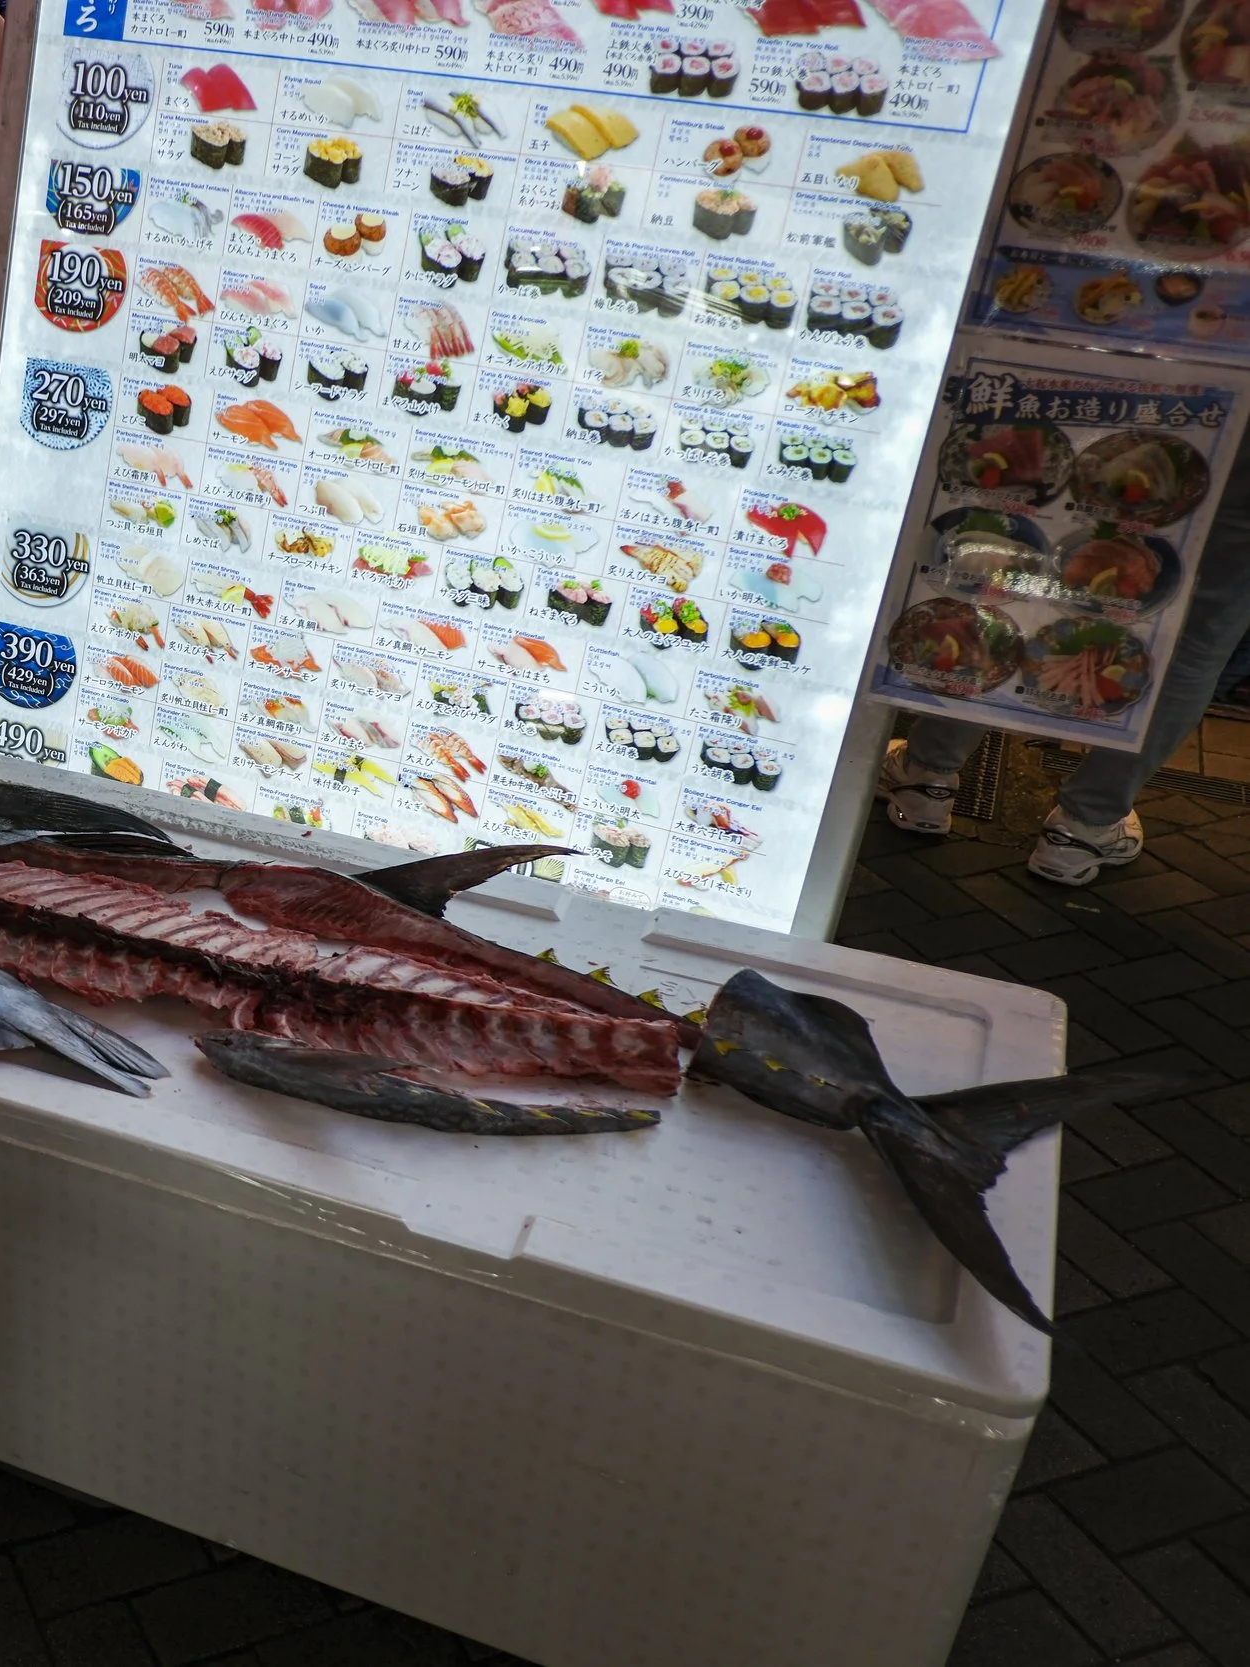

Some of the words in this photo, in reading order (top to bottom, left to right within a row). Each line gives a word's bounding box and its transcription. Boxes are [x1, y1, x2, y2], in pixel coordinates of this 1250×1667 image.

[132, 12, 166, 24] 本まぐろ
[897, 66, 942, 78] 本まぐろ
[71, 62, 147, 103] 100yen
[164, 96, 190, 108] まぐろ
[160, 113, 173, 121] Tuna
[280, 109, 329, 124] するめいか
[78, 121, 92, 130] Tax
[402, 124, 432, 137] こはだ
[158, 138, 176, 147] ツナ
[529, 138, 550, 150] 玉子
[157, 149, 184, 161] サラダ
[274, 152, 300, 162] コーン
[272, 164, 300, 176] サラダ
[59, 164, 133, 206] 150yen
[392, 180, 421, 191] コーン
[65, 221, 77, 229] Tax
[651, 213, 674, 226] 納豆
[49, 250, 123, 292] 190yen
[136, 297, 154, 307] えび
[54, 306, 68, 315] Tax
[305, 324, 324, 335] いか
[393, 338, 423, 351] 甘えび
[32, 370, 107, 411] 270yen
[121, 414, 146, 426] とびこ
[39, 423, 51, 431] Tax
[212, 430, 249, 444] サーモン
[101, 541, 120, 550] Scallop
[185, 533, 219, 549] しめさば
[12, 530, 90, 574] 330yen
[21, 581, 32, 589] Tax
[0, 632, 75, 674] 390yen
[8, 681, 19, 689] Tax
